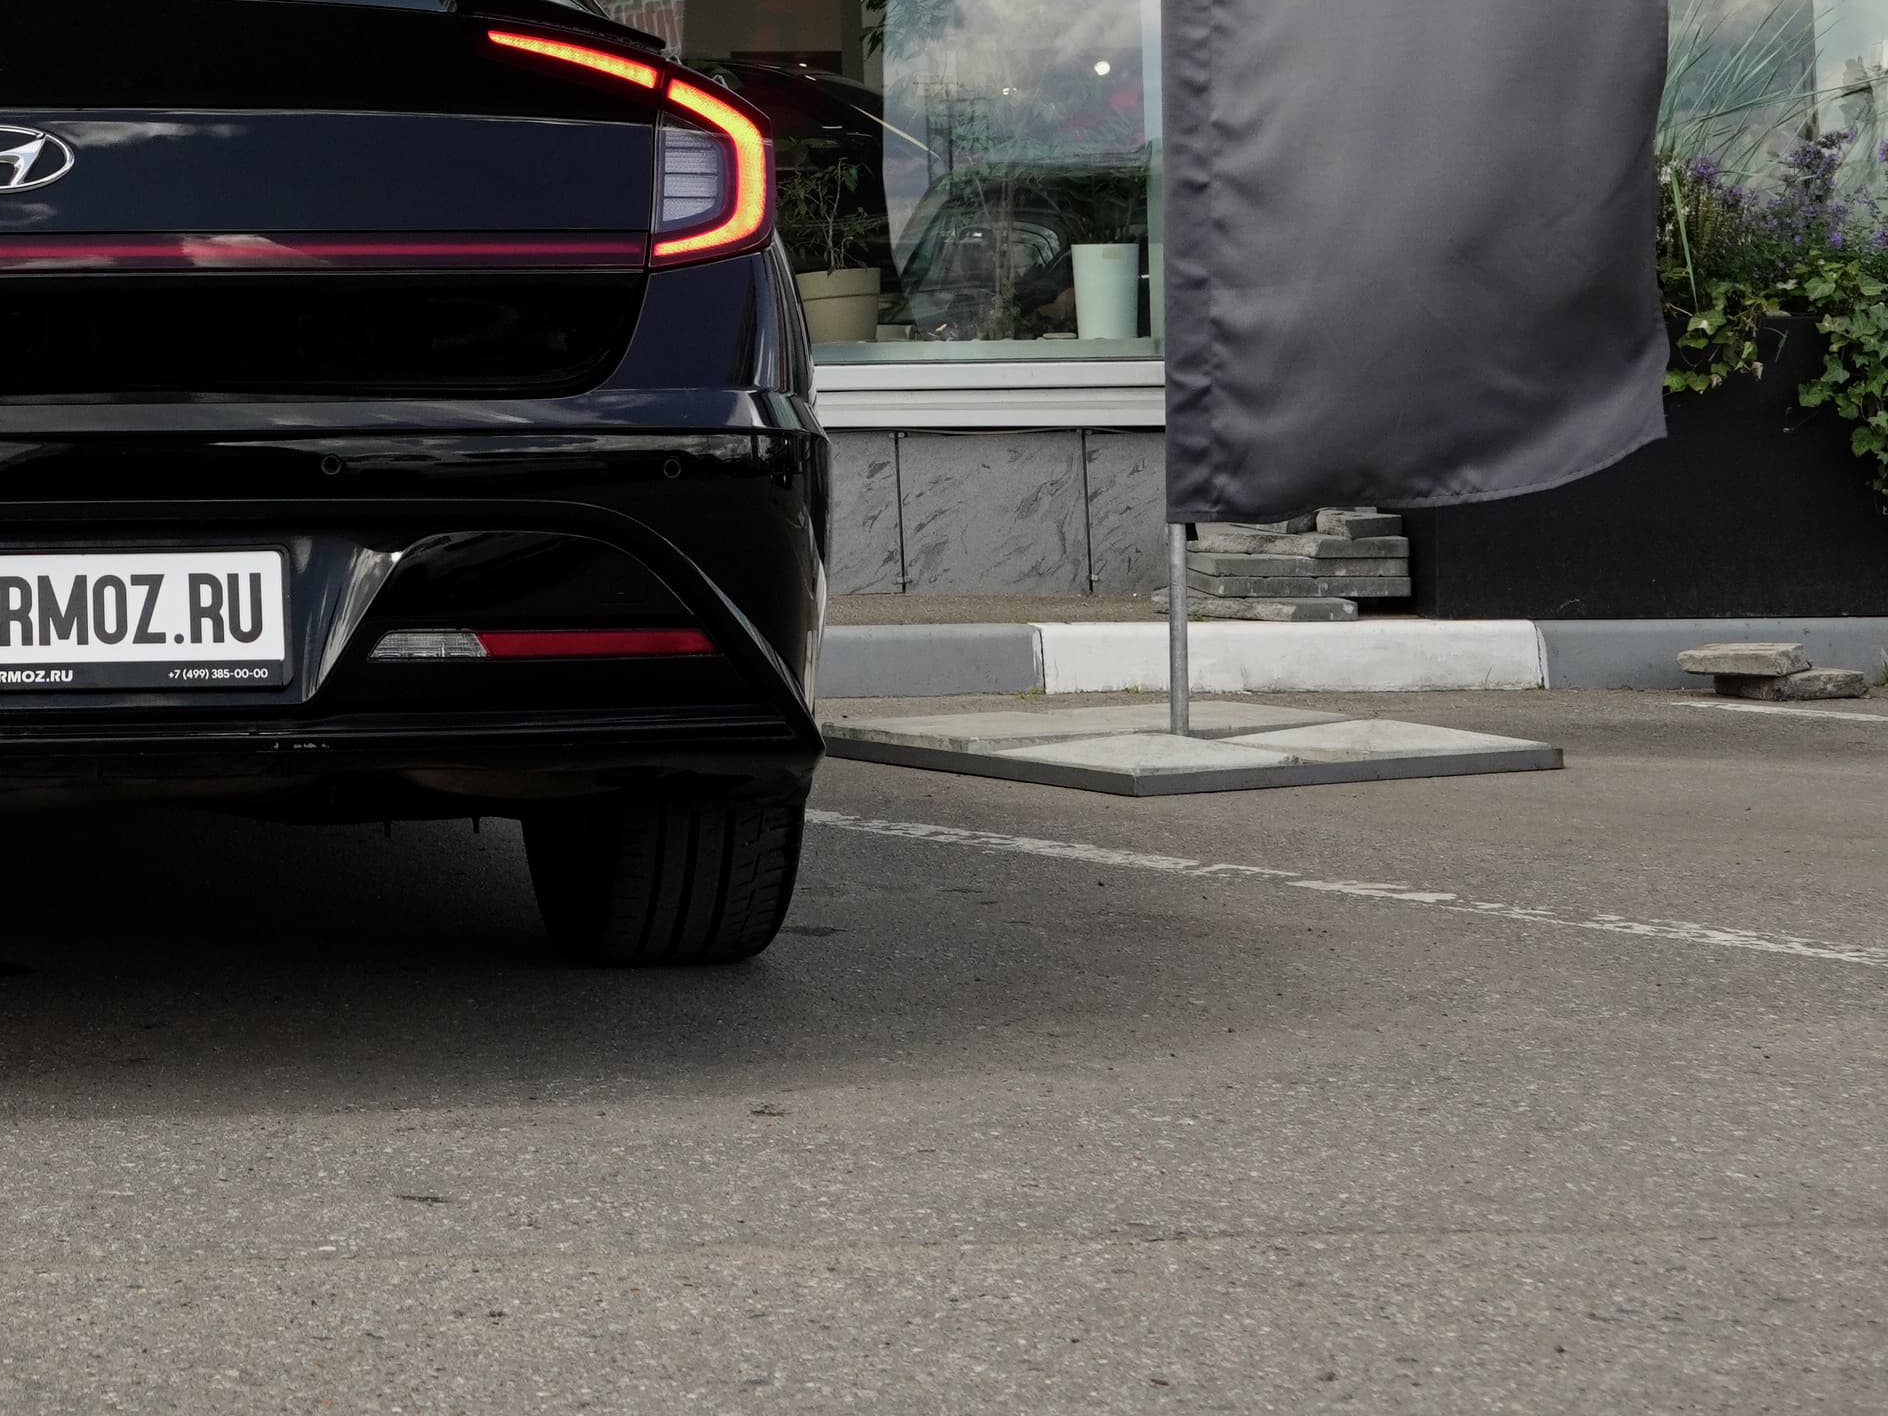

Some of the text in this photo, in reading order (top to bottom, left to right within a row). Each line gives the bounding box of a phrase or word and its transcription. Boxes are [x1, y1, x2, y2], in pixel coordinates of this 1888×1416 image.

[168, 668, 268, 680] +7 (499) 385-00-00
